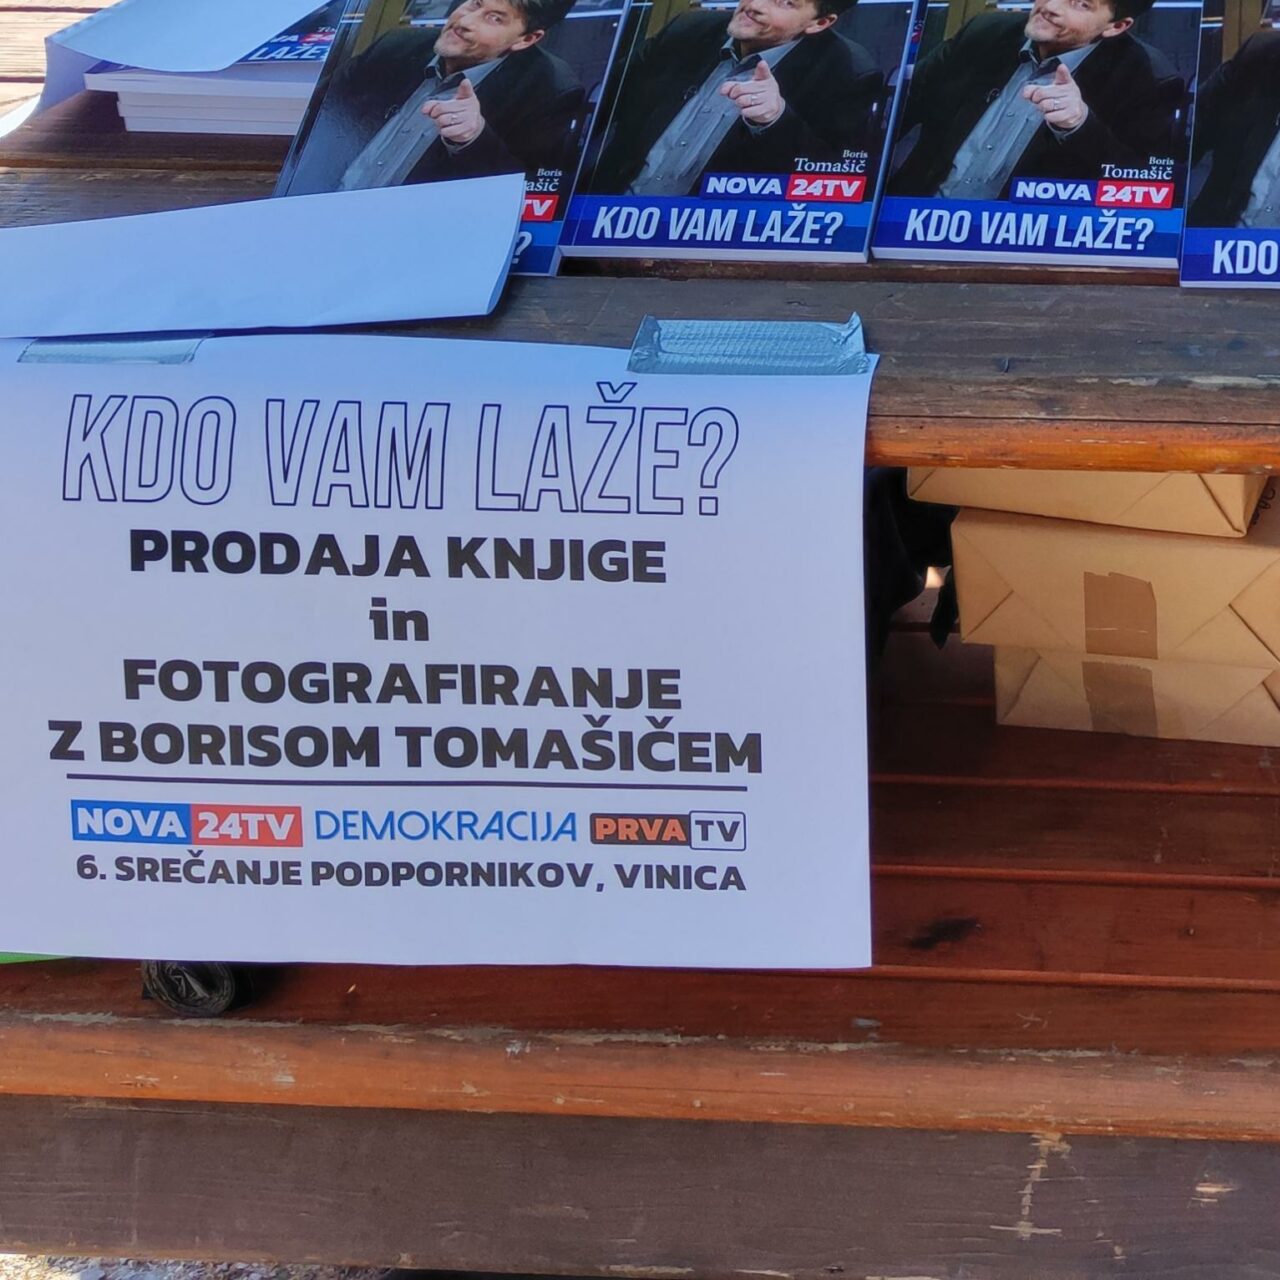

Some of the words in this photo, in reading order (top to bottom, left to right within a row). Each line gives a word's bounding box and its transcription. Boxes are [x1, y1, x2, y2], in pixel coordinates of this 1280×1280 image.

[794, 158, 867, 173] Tomašič
[842, 149, 868, 159] Boris
[1101, 163, 1173, 181] Tomašič
[1149, 156, 1175, 166] Boris
[524, 178, 560, 192] ašič
[537, 168, 563, 177] Boris
[706, 176, 782, 196] NOVA
[791, 179, 862, 198] 24TV
[520, 199, 554, 217] TV
[1015, 181, 1092, 202] NOVA
[1100, 185, 1169, 204] 24TV
[592, 206, 660, 240] KDO
[668, 207, 738, 242] VAM
[742, 203, 844, 245] LAŽE?
[904, 208, 972, 244] KDO
[980, 211, 1049, 246] VAM
[1054, 209, 1155, 251] LAŽE?
[1212, 239, 1279, 275] KDO
[62, 393, 237, 506] KDO
[265, 398, 451, 510] VAM
[475, 381, 740, 517] LAŽE?
[129, 528, 431, 578] PRODAJA
[447, 536, 667, 584] KNJIGE
[368, 596, 430, 642] in
[123, 658, 682, 710] FOTOGRAFIRANJE
[47, 719, 86, 762] Z
[98, 721, 381, 769] BORISOM
[394, 713, 763, 775] TOMAŠIČEM
[76, 807, 187, 840] NOVA
[197, 811, 295, 842] 24TV
[314, 809, 578, 842] DEMOKRACIJA
[594, 817, 687, 843] PRVA
[694, 819, 741, 843] TV
[75, 853, 107, 881] 6.
[114, 848, 303, 886] SREČANJE
[311, 860, 606, 893] PODPORNIKOV,
[613, 863, 747, 892] VINICA
